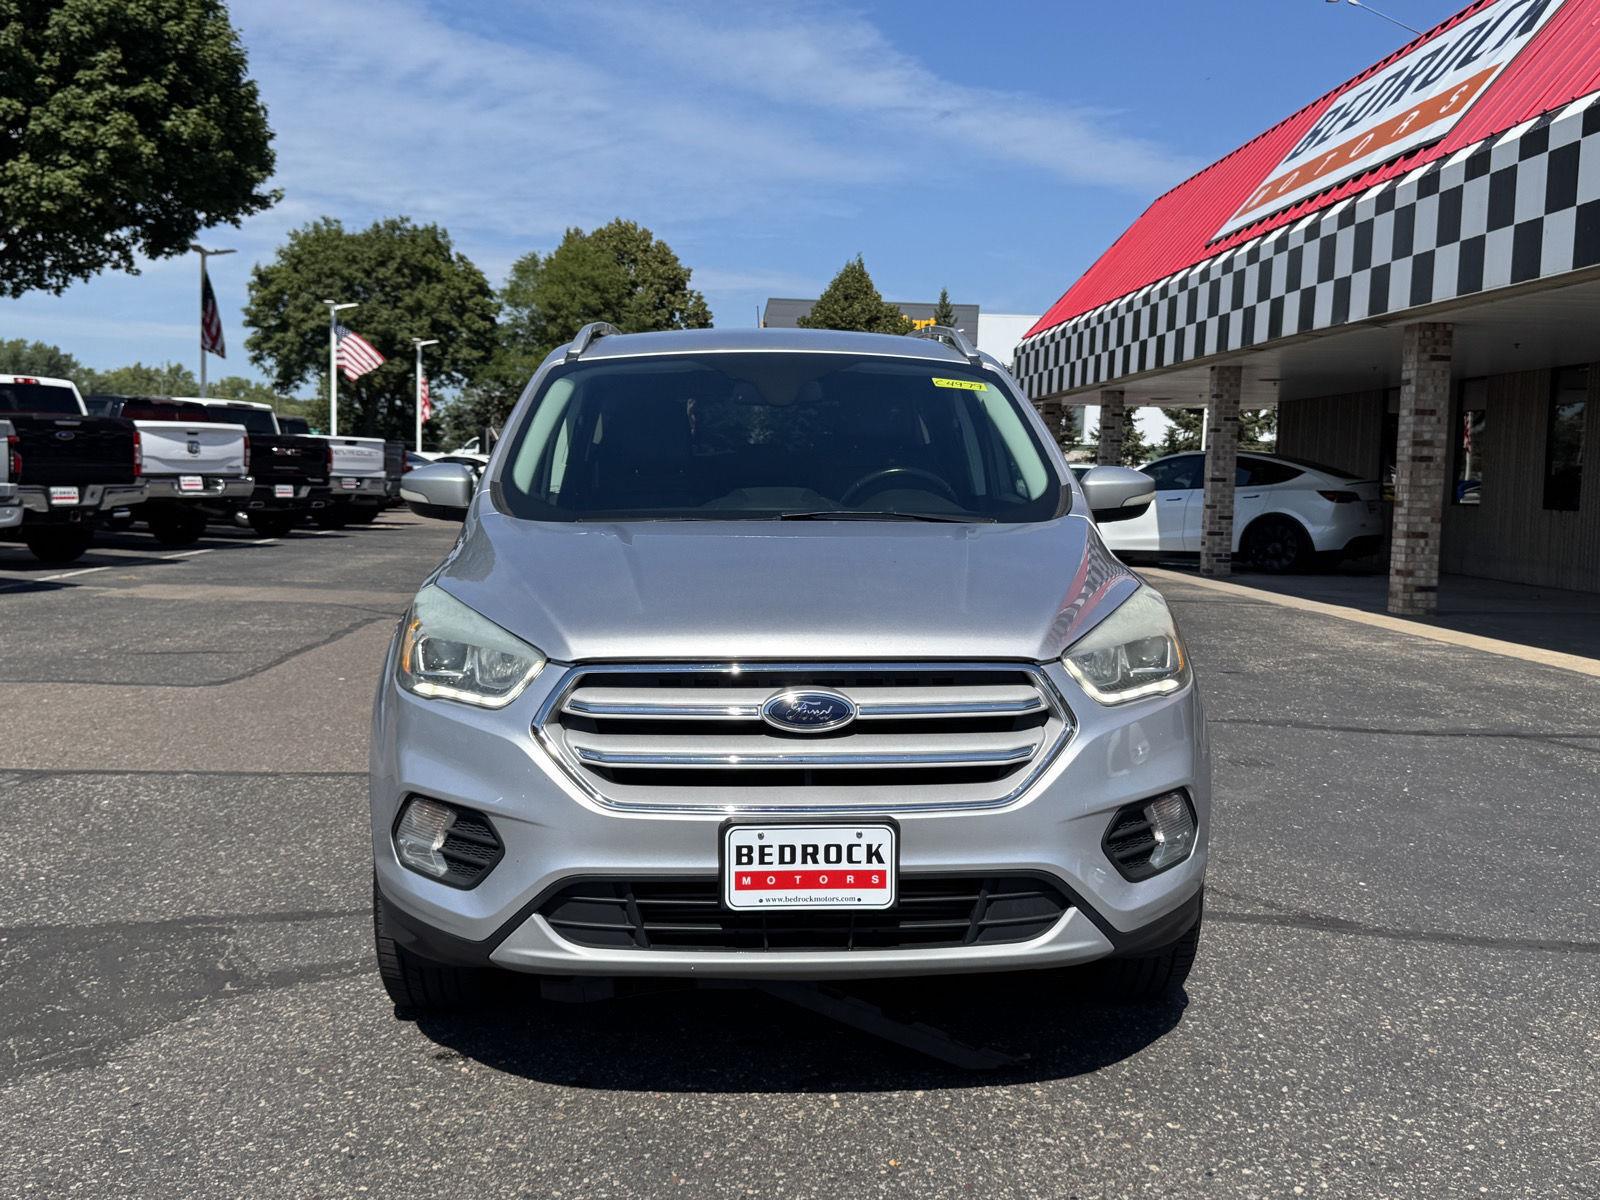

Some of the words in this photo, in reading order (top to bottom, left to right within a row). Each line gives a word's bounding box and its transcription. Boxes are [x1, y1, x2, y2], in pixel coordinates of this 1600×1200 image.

[1283, 0, 1552, 164] BEDROCK
[1247, 84, 1470, 209] MOTORS
[735, 843, 885, 865] BEDROCK
[741, 875, 880, 885] MOTORS
[765, 895, 856, 903] www.bedrockmotors.com
